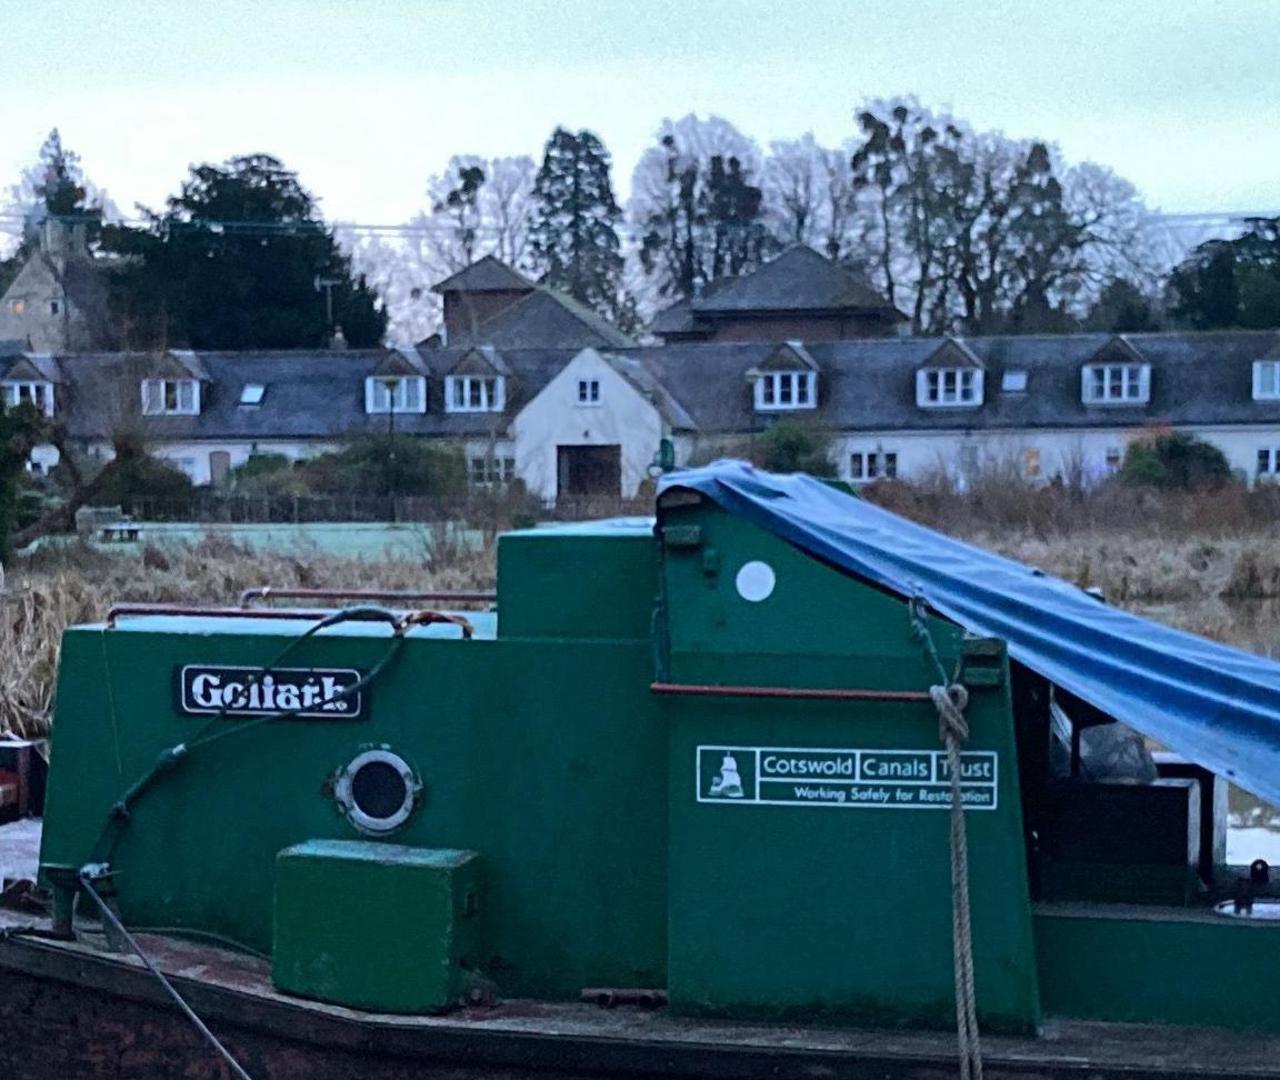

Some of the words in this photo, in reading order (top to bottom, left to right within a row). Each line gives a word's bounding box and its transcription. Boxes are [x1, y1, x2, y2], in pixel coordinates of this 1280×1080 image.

[764, 756, 852, 775] Cotswold
[863, 758, 928, 777] Canals
[939, 759, 991, 777] Tust
[794, 787, 845, 803] Working
[851, 788, 890, 803] Safely
[896, 788, 913, 801] for
[919, 789, 990, 803] Restoation
